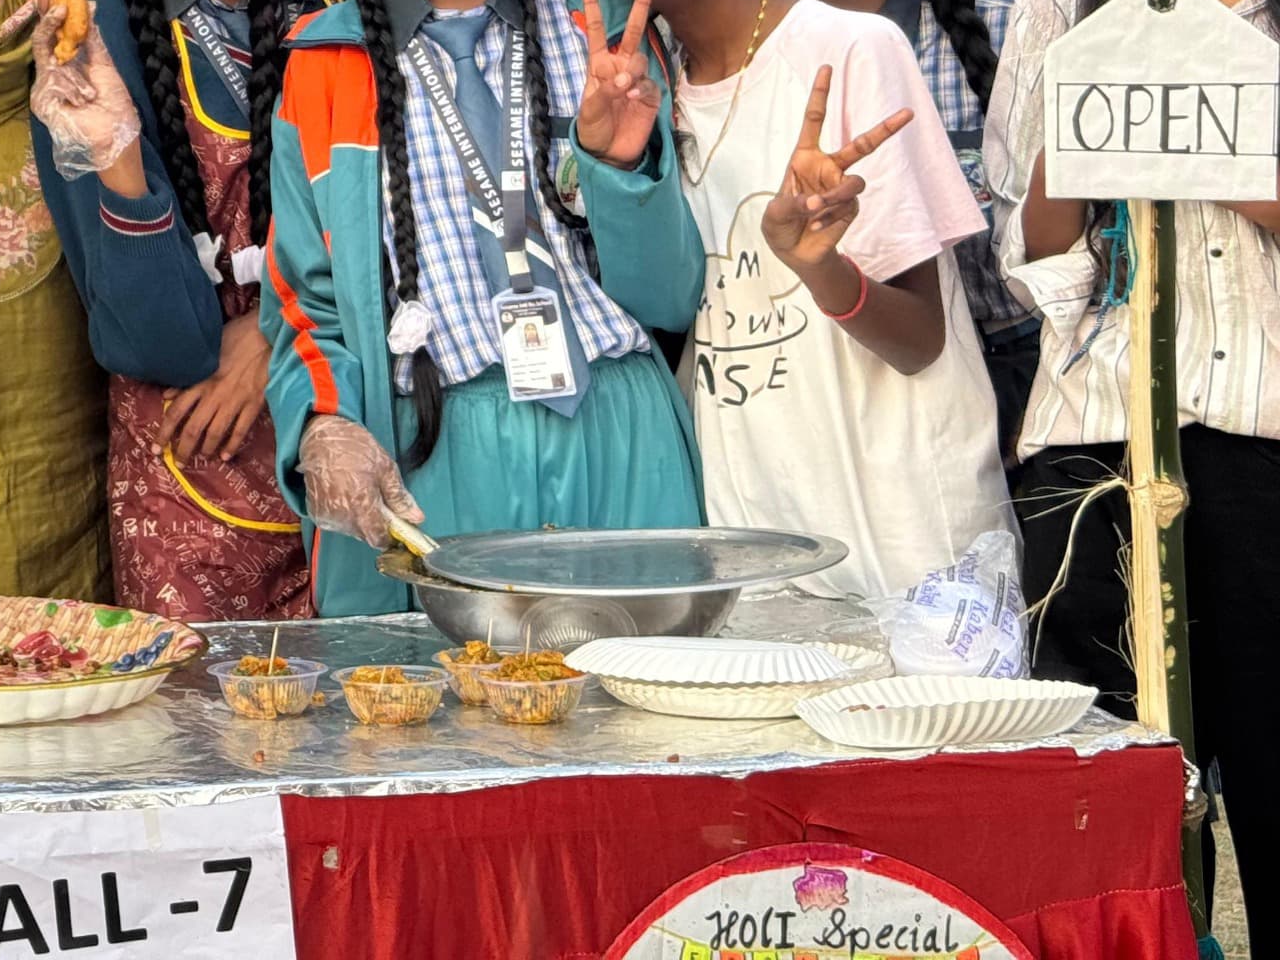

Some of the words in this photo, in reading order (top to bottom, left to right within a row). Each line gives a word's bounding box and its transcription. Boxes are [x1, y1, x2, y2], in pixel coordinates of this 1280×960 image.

[412, 47, 476, 157] INTERNATIONAL
[1073, 83, 1244, 157] OPEN
[510, 109, 525, 168] SESAME
[468, 160, 505, 218] SESAME
[952, 599, 990, 663] Kaberi
[813, 908, 960, 957] Special
